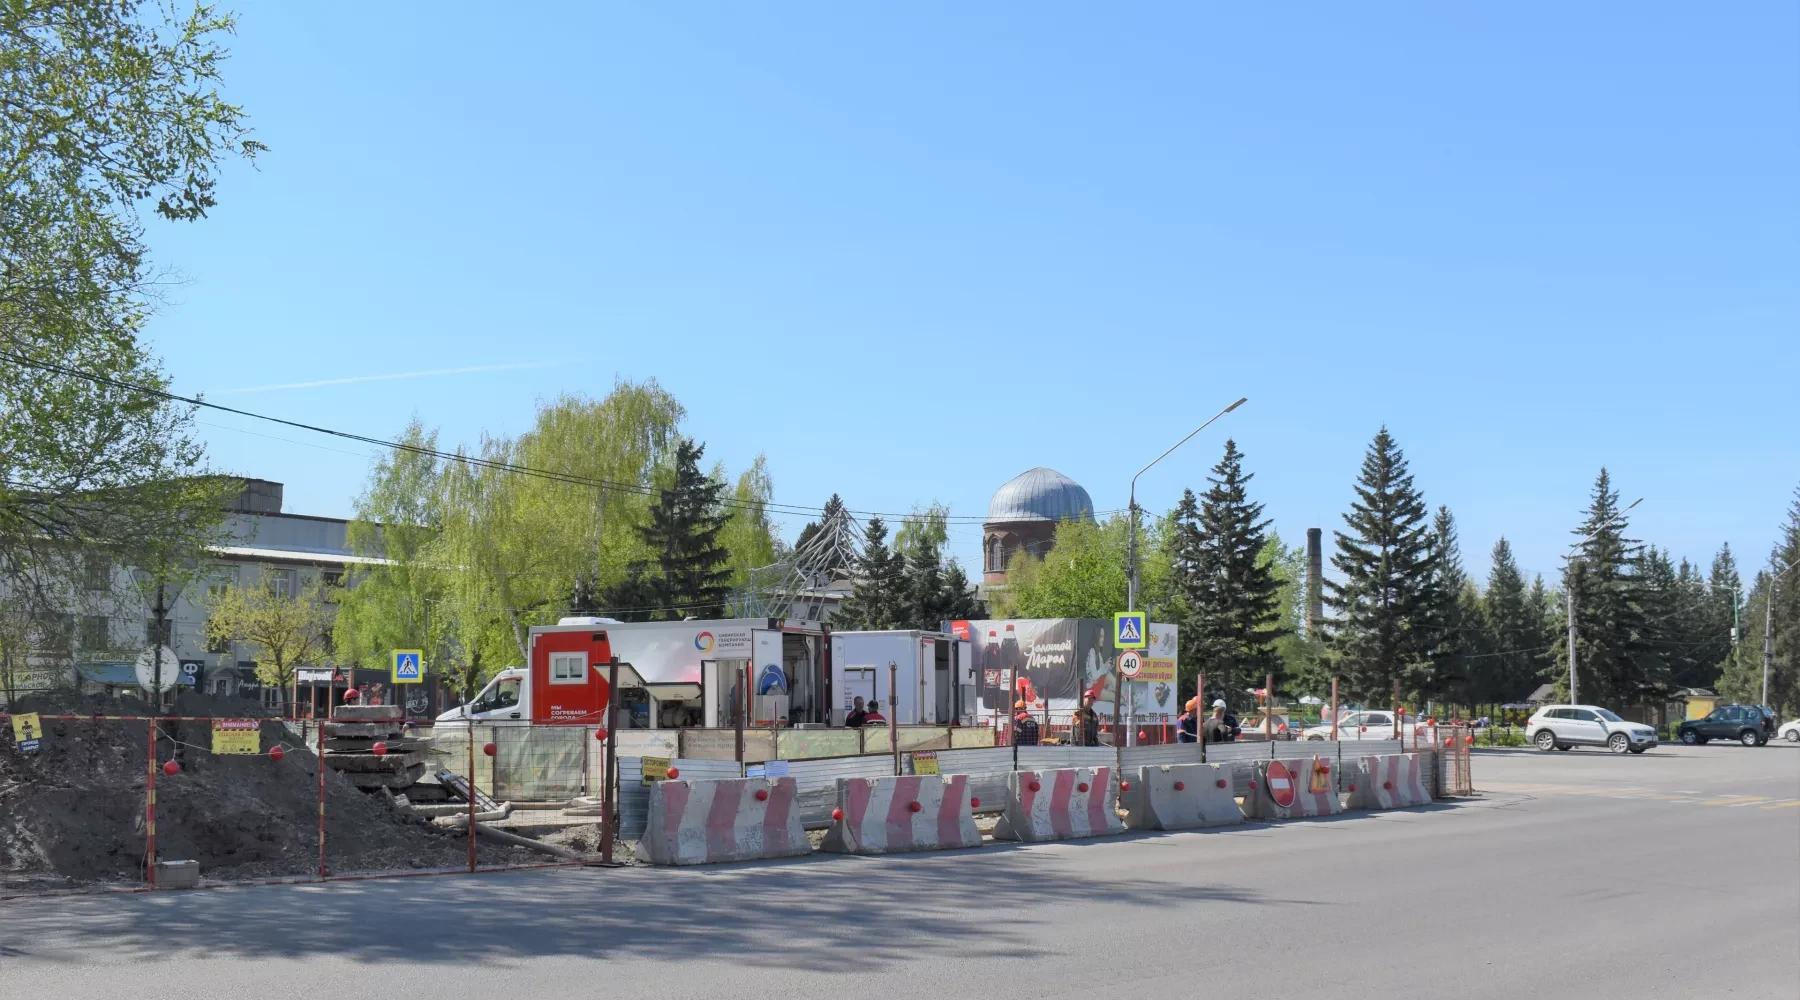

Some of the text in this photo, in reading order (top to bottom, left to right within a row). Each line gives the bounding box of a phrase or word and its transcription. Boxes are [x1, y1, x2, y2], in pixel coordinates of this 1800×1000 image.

[1023, 639, 1072, 657] Золотой
[1025, 653, 1066, 671] Марал
[1124, 658, 1137, 669] 40
